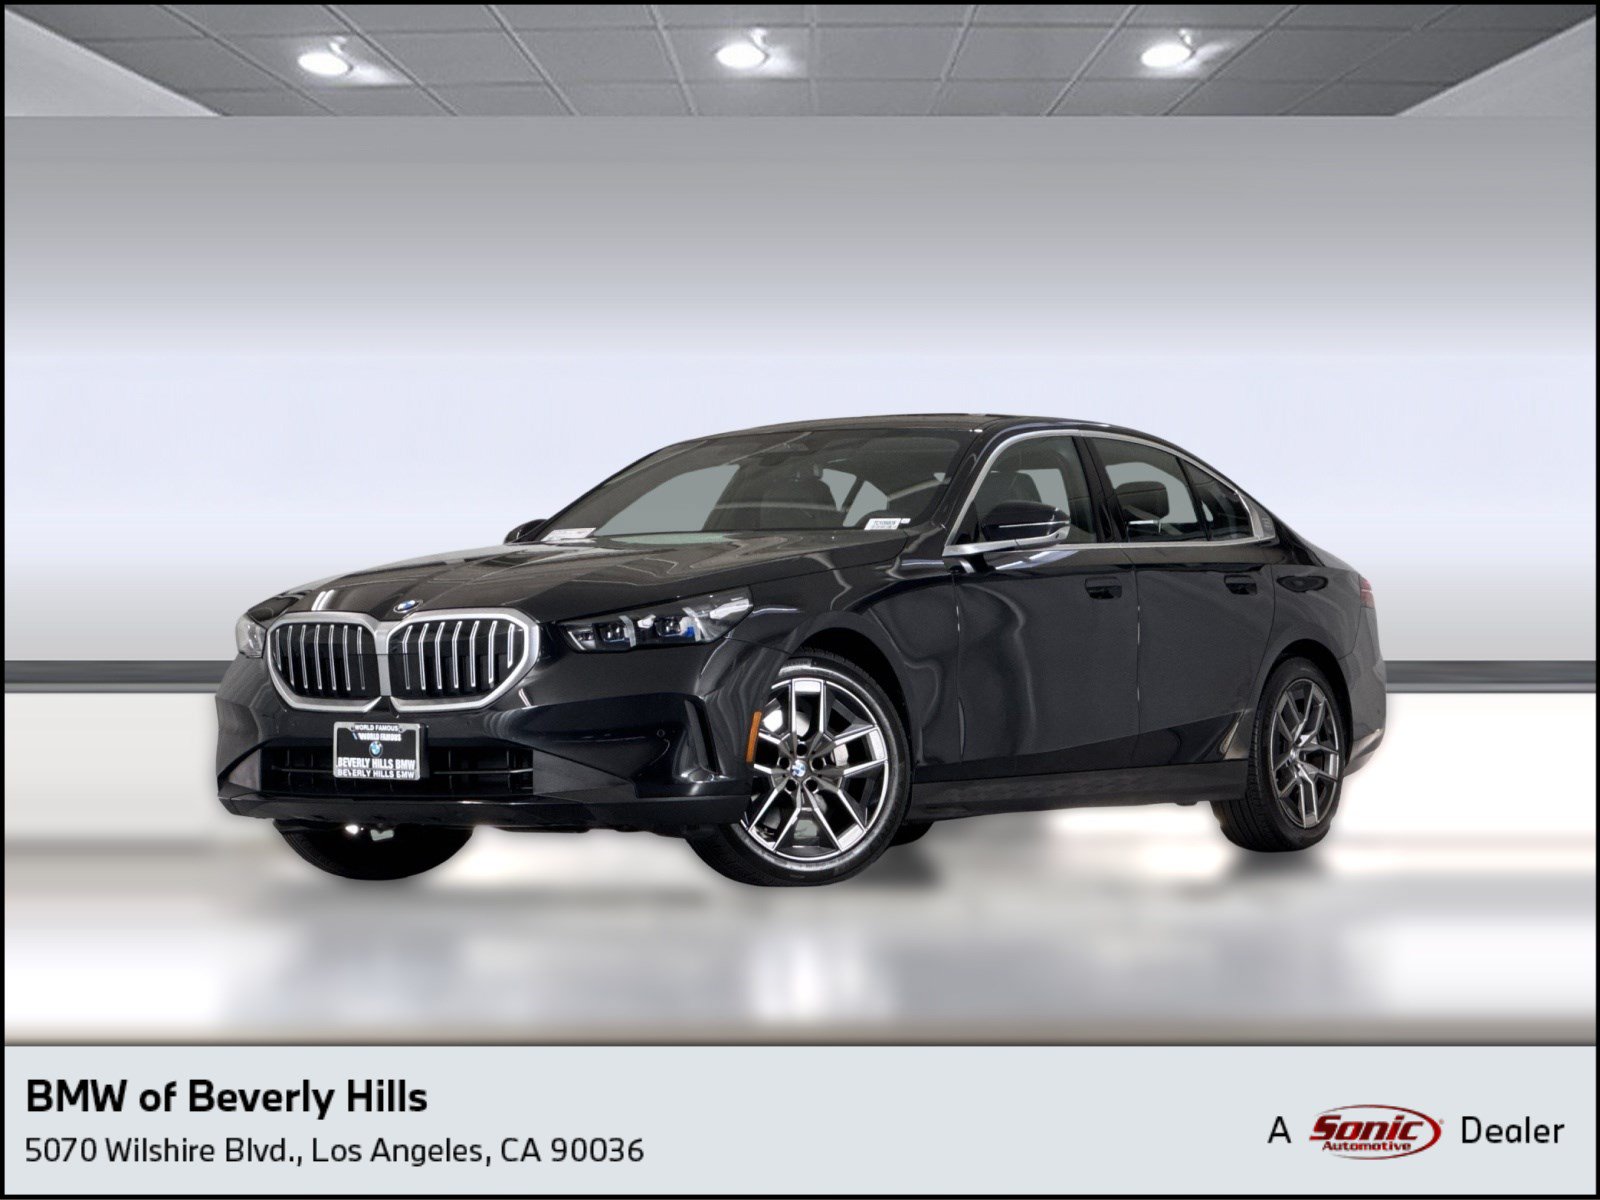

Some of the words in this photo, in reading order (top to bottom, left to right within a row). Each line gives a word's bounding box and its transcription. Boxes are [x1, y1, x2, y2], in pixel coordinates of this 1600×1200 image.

[375, 724, 399, 732] FAMOUS
[338, 757, 370, 768] BEVERLY
[371, 758, 394, 769] HILLS
[395, 759, 416, 770] BMW
[338, 769, 371, 777] BEVERLY
[372, 769, 394, 778] HILLS
[396, 769, 415, 779] BMW
